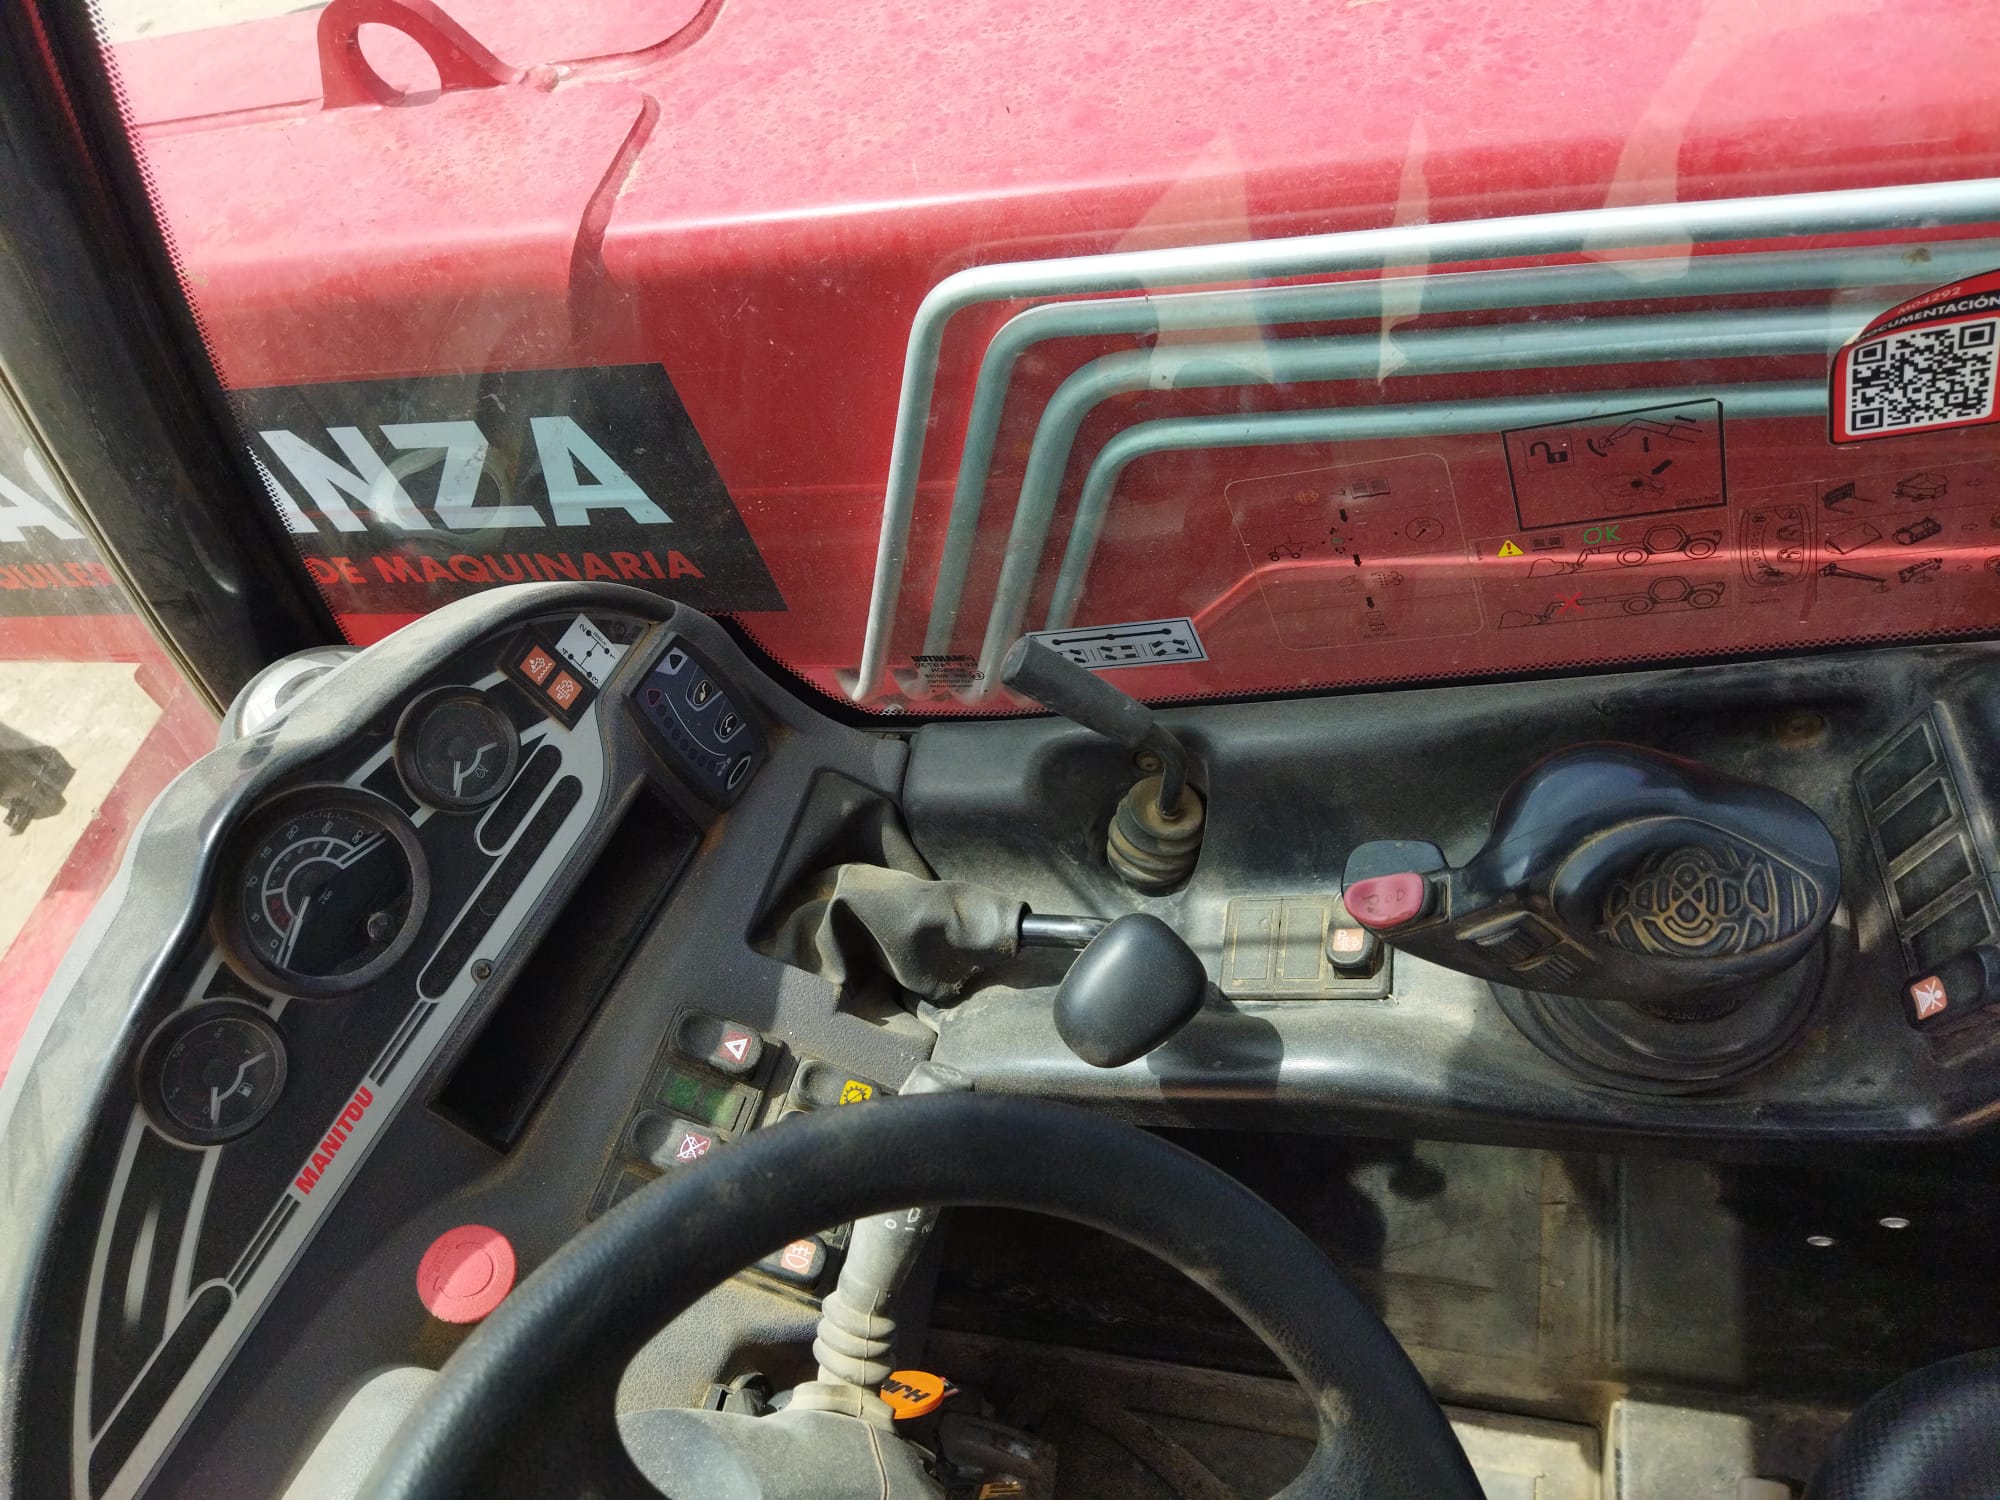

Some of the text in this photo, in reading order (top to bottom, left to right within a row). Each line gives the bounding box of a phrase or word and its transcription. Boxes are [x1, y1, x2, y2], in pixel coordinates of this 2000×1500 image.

[1583, 525, 1621, 544] OK
[303, 556, 368, 584] DE
[371, 550, 705, 584] MAQUINARIA
[270, 939, 279, 949] 0
[294, 1085, 374, 1196] MANITOU
